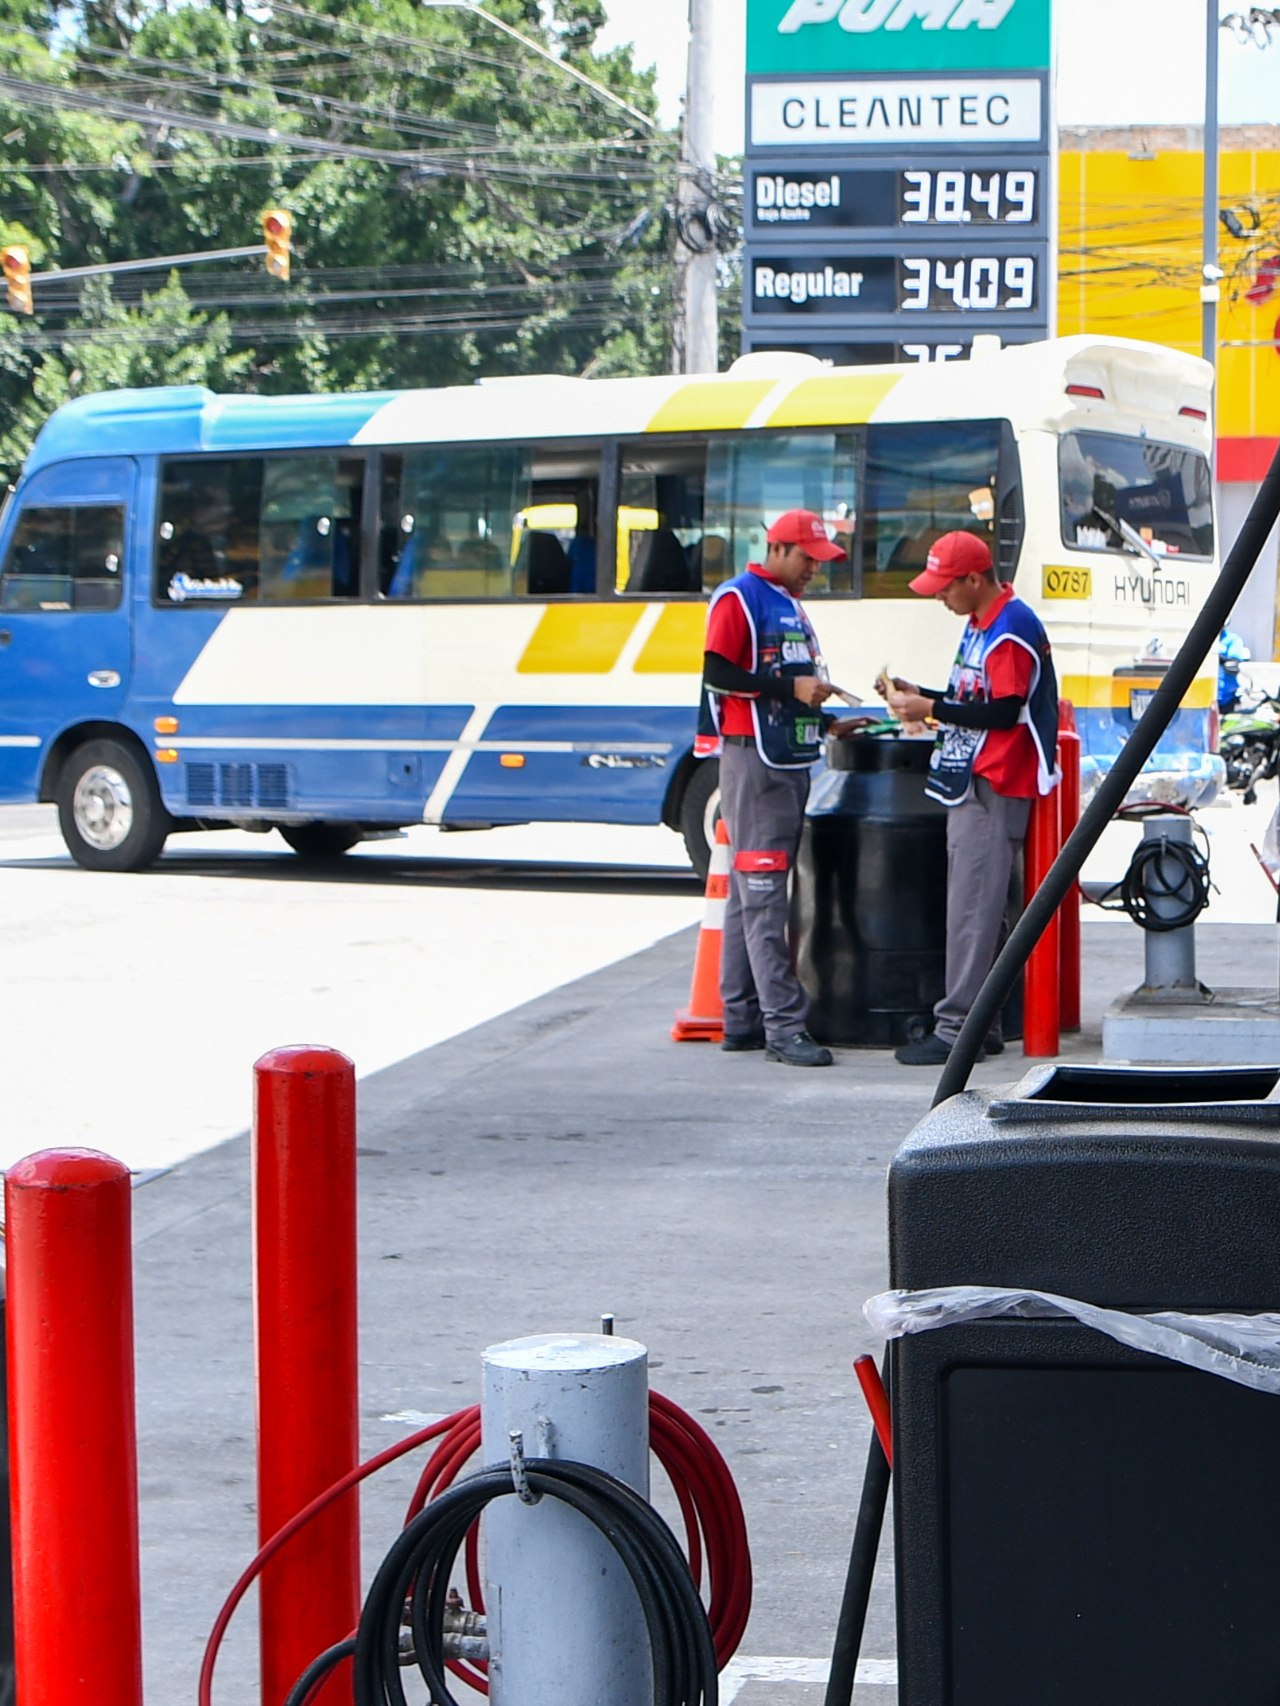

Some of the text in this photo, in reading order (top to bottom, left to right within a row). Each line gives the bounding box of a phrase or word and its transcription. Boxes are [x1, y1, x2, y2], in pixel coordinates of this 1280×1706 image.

[782, 95, 1010, 129] CLEANTEC
[756, 171, 1035, 223] Diesel 38.49
[755, 257, 1034, 309] Regular 34.09
[1114, 575, 1191, 605] HYUNDAI
